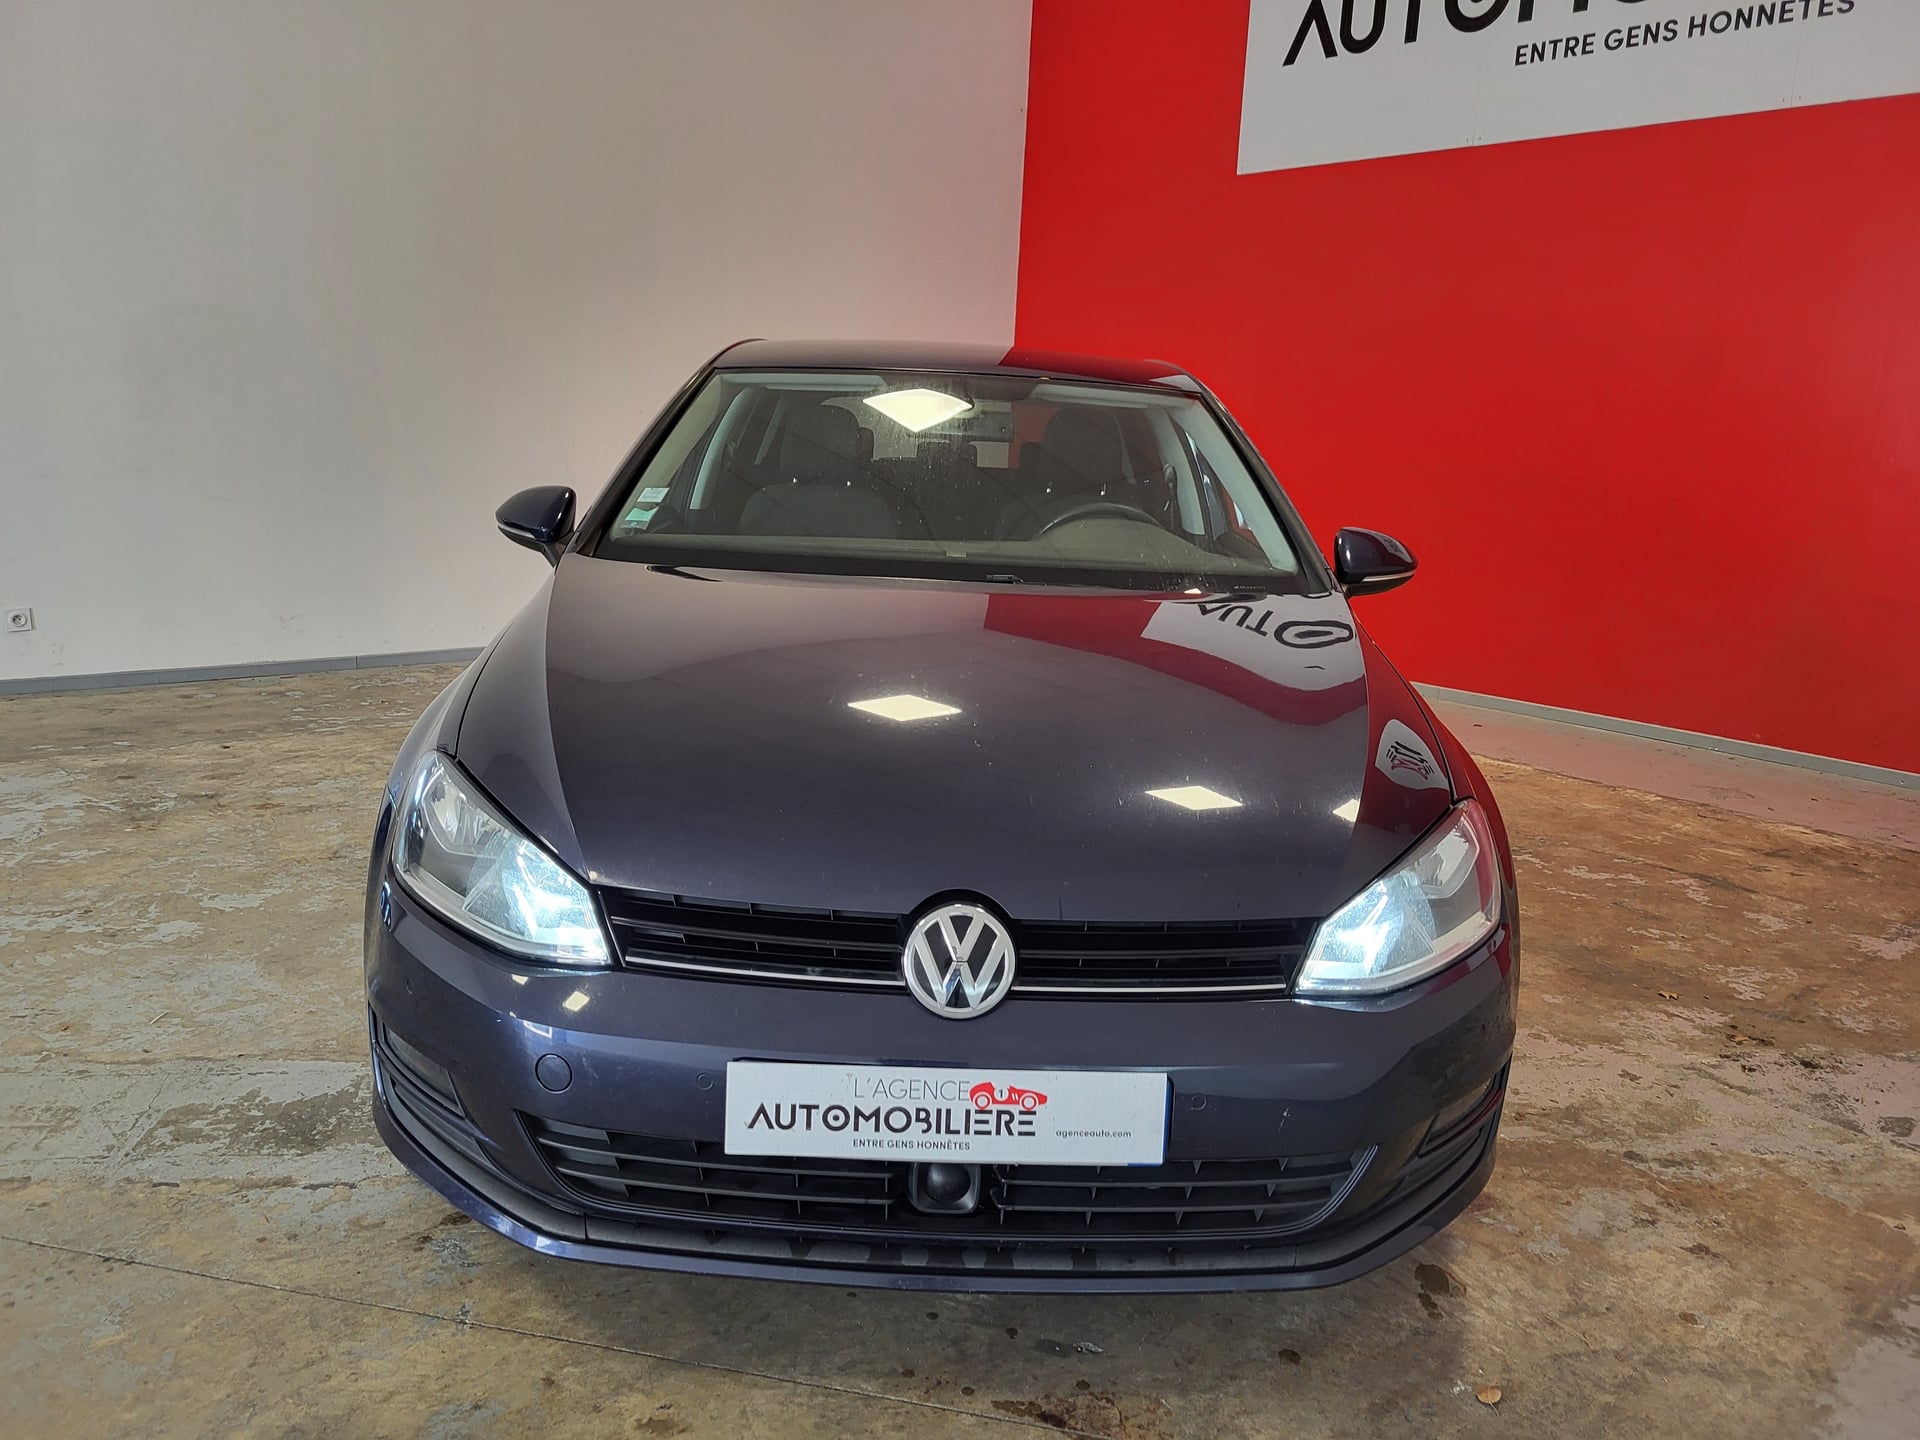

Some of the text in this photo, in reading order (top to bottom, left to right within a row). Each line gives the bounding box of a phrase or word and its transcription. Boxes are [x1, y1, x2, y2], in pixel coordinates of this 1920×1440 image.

[1515, 32, 1596, 66] ENTRE
[1604, 19, 1678, 51] GENS
[853, 1078, 970, 1101] L'AGENCE
[1055, 1129, 1132, 1139] agenceauto.com
[853, 1138, 971, 1150] ENTRE GENS HONNÊTES
